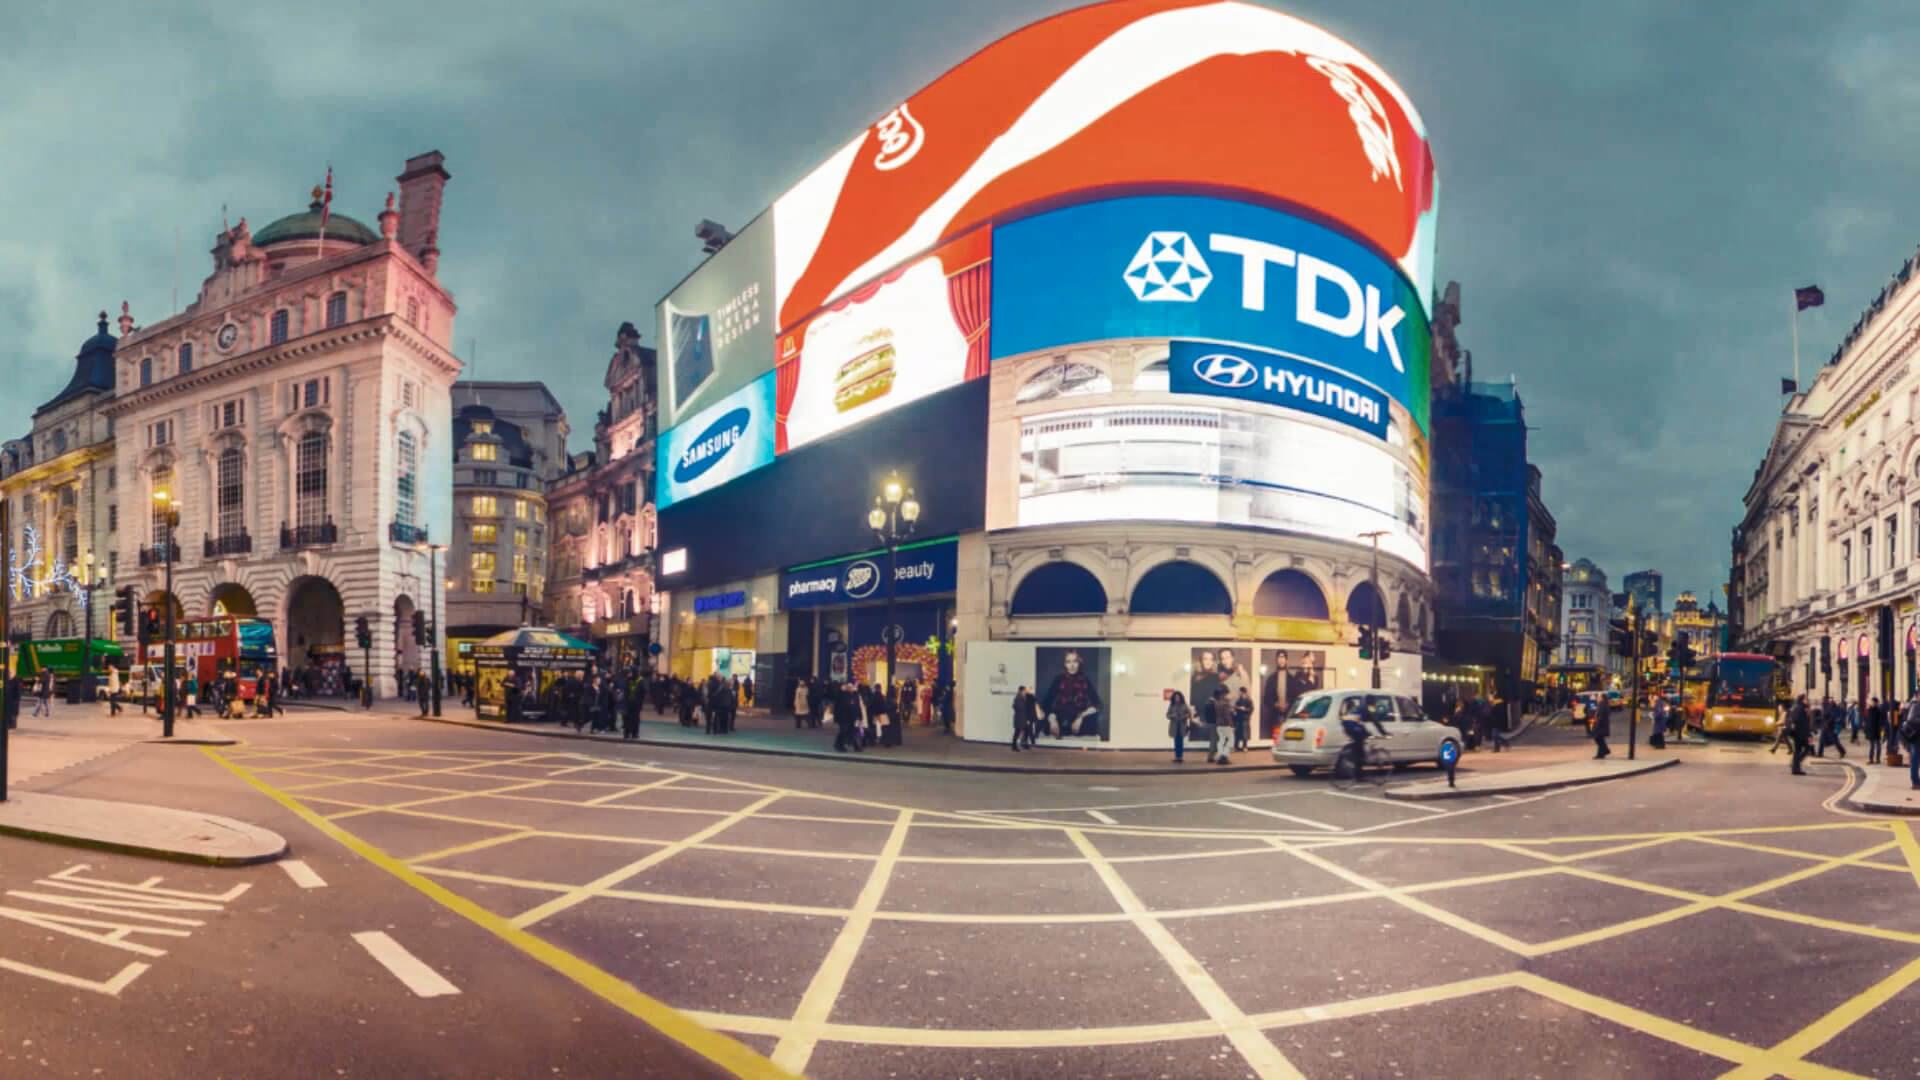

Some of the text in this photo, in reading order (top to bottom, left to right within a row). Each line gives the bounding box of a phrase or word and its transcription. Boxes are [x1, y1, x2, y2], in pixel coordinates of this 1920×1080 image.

[716, 281, 760, 320] TIMELESS
[1209, 233, 1406, 374] TDK
[716, 312, 760, 349] DESIGN
[1263, 366, 1380, 424] HYUNDAI
[682, 424, 740, 468] SAMSUNG
[788, 577, 838, 597] pharmacy
[0, 864, 253, 999] LANE
